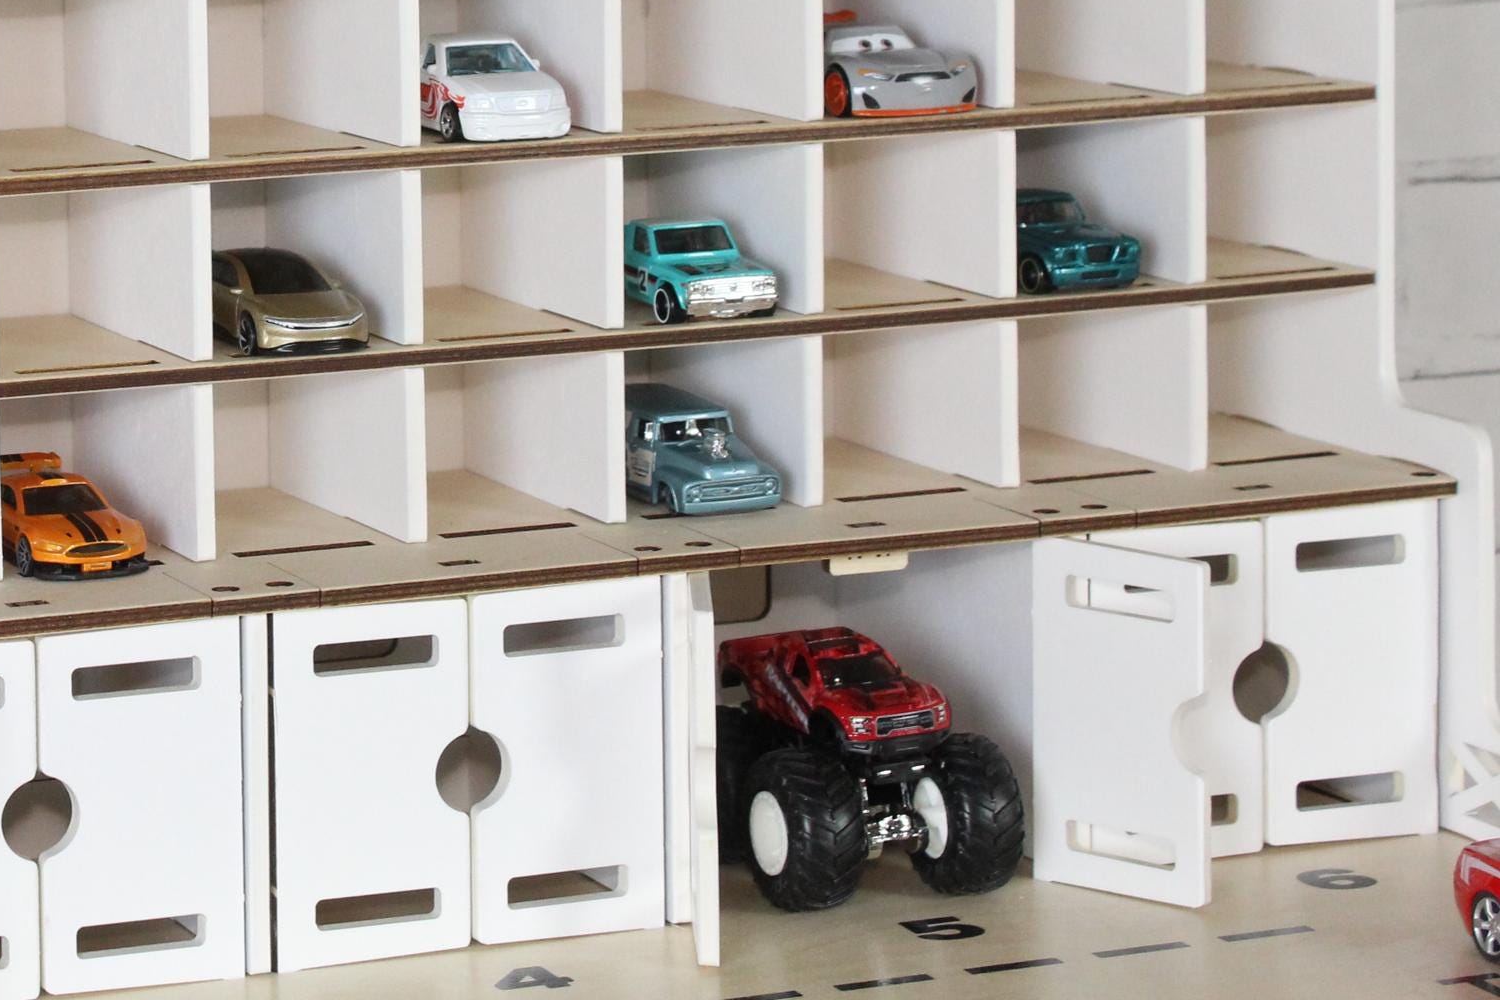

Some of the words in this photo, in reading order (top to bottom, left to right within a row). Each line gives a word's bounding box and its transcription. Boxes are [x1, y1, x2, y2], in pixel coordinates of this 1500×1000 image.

[1296, 868, 1378, 890] 6
[897, 915, 986, 941] 5
[494, 966, 575, 990] 4
